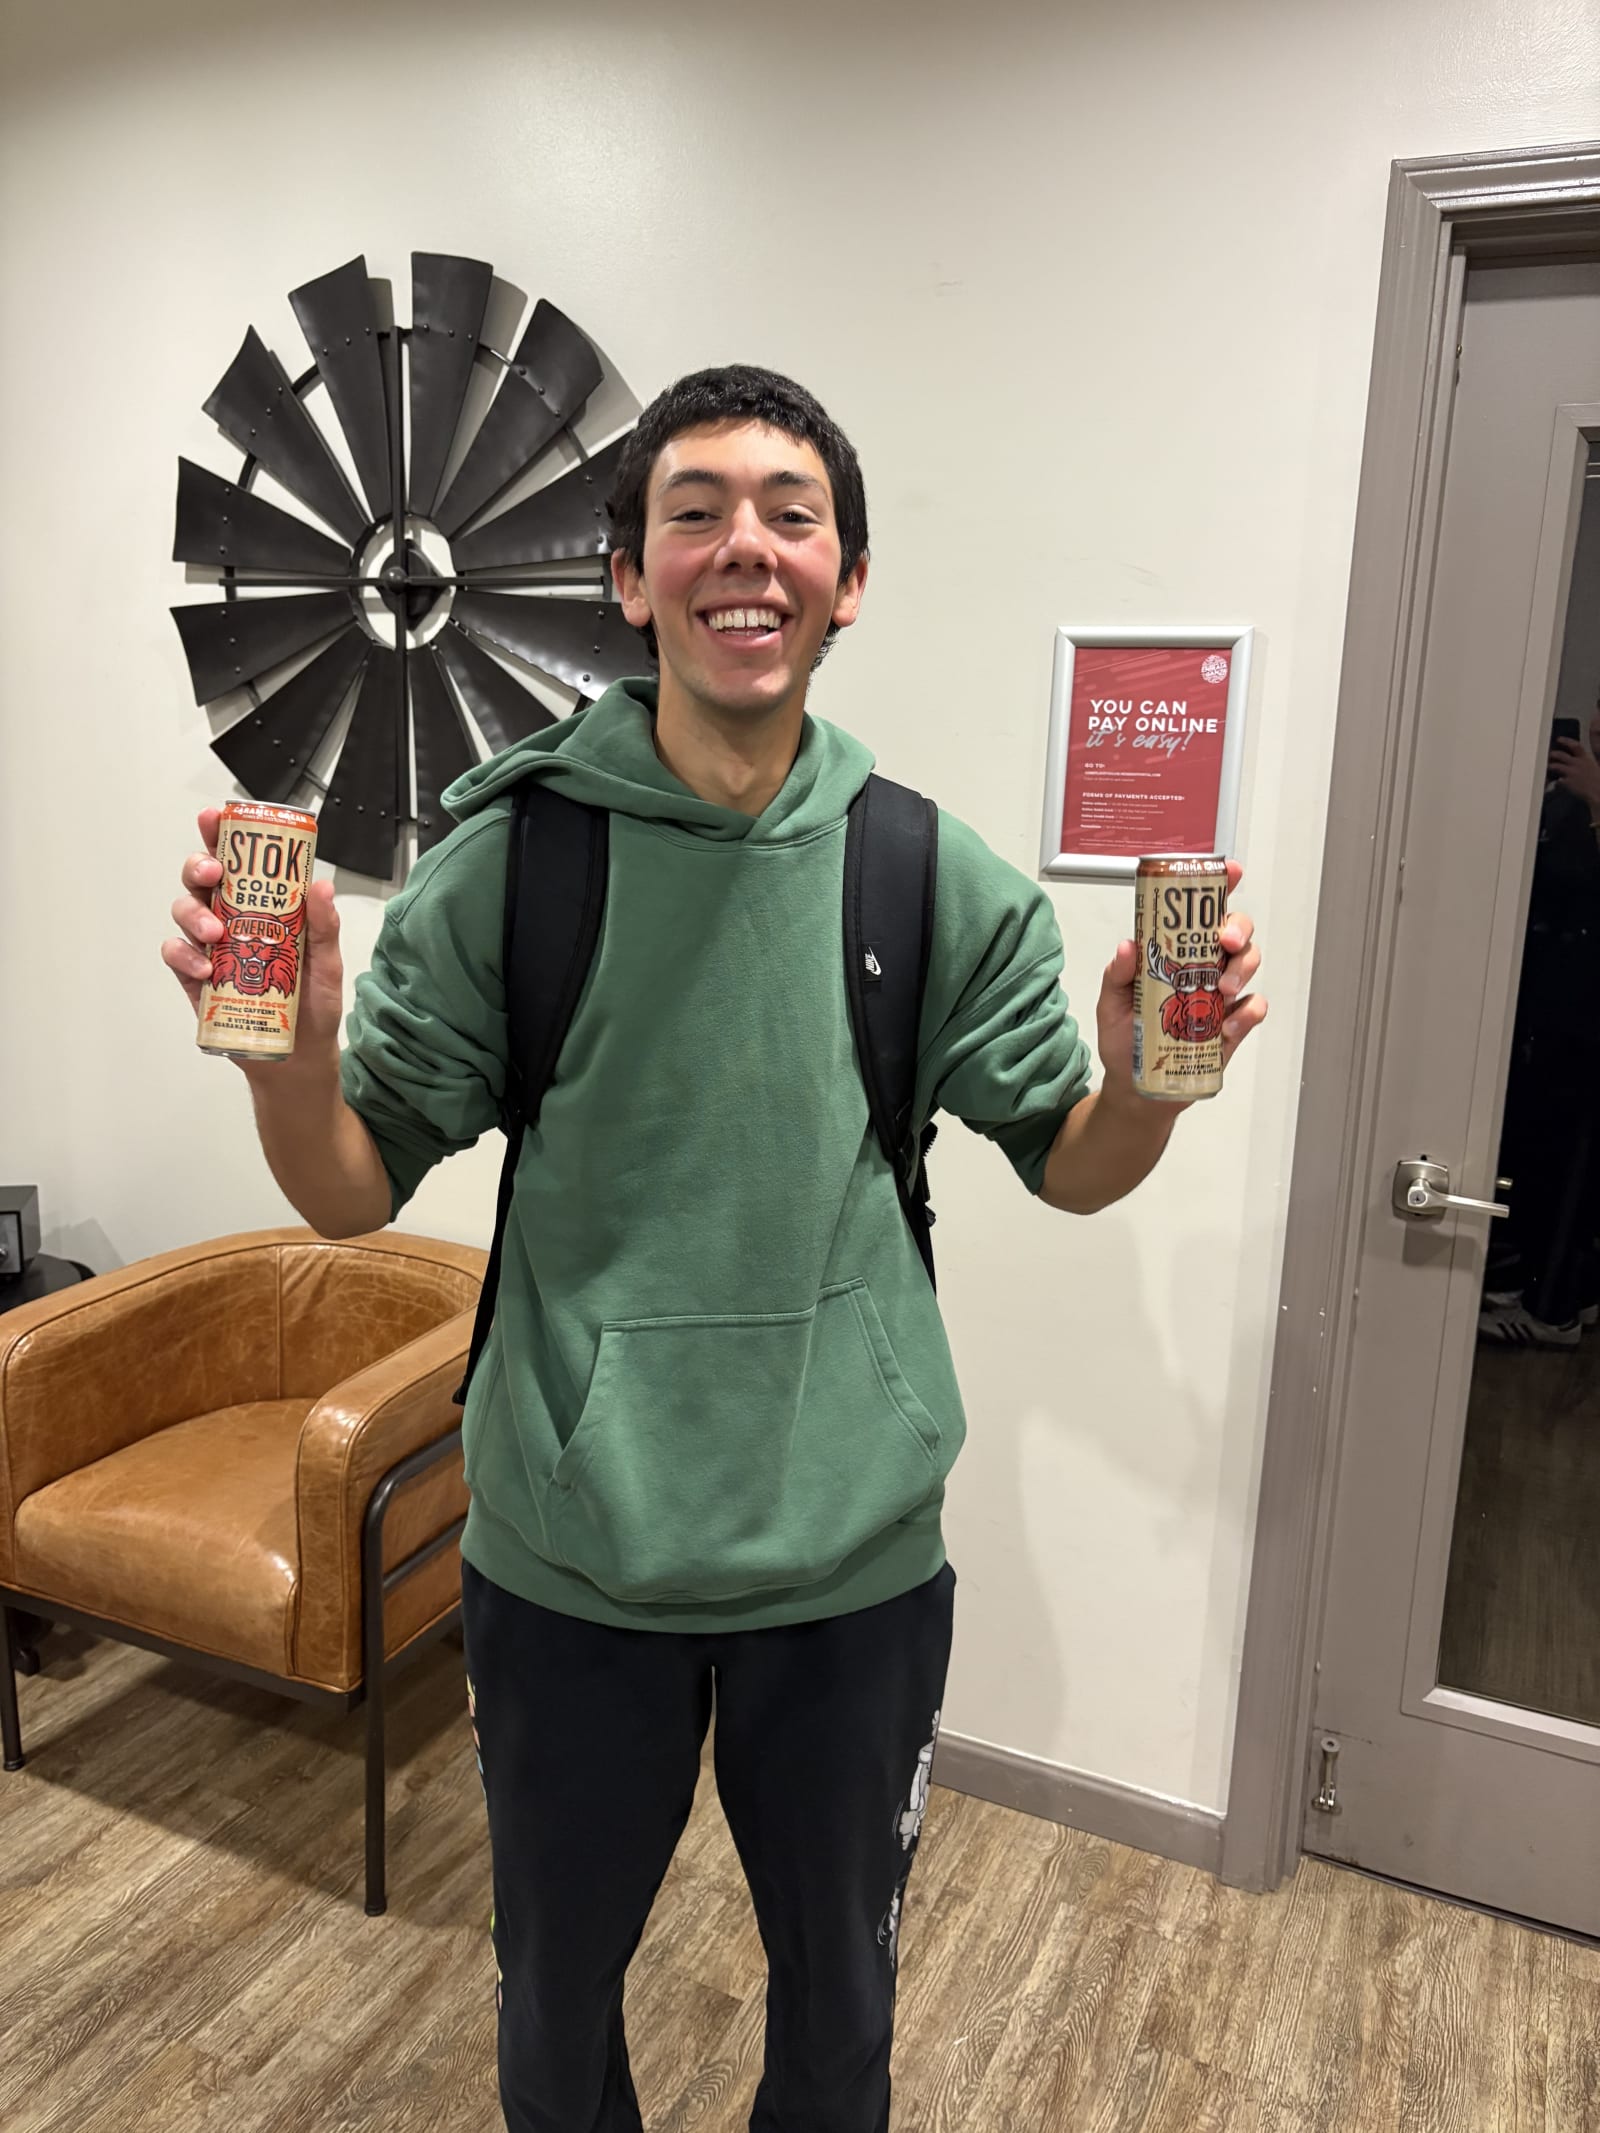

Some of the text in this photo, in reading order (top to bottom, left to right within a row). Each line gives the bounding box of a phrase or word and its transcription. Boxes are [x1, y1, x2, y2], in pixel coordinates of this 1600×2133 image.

[1090, 699, 1187, 715] YOU CAN
[1088, 716, 1217, 733] PAY ONLINE
[1085, 727, 1195, 758] it's easy!
[233, 806, 274, 818] CARAMEL
[237, 878, 288, 896] COLD
[236, 892, 288, 909] BREW
[232, 919, 281, 940] ENERGY
[1177, 932, 1220, 944] COLD
[1177, 945, 1220, 958] BREW
